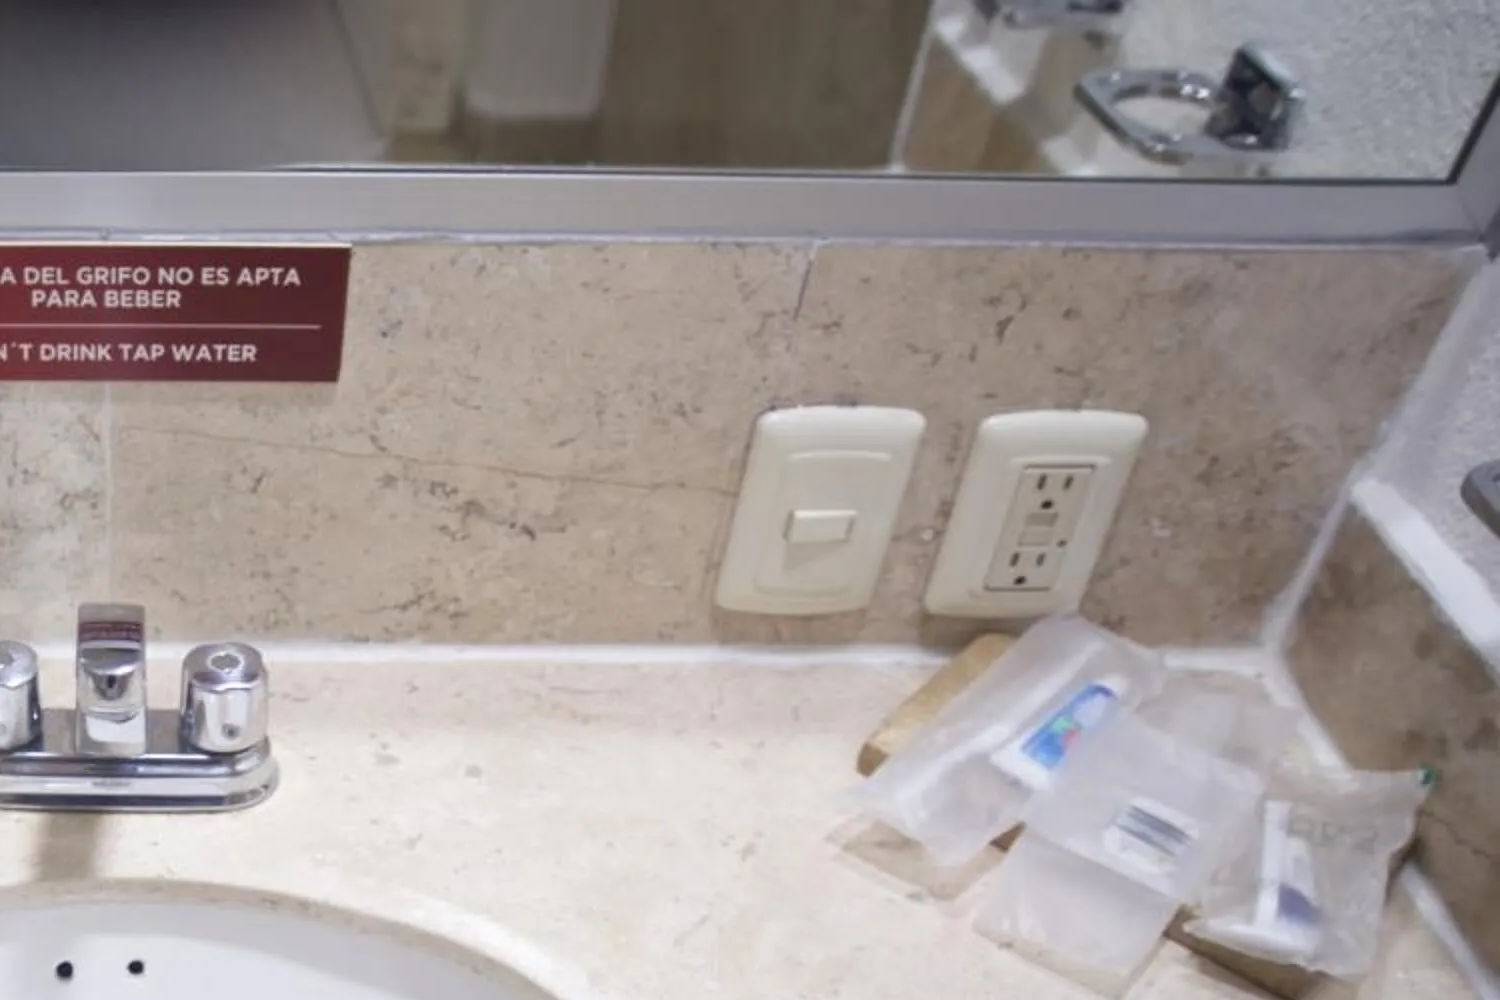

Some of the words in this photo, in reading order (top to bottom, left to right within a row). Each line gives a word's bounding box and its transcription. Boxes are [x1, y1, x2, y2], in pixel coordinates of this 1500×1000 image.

[23, 267, 70, 285] DEL
[75, 266, 151, 286] GRIFO
[157, 266, 194, 286] NO
[200, 267, 229, 286] ES
[236, 267, 301, 286] APTA
[31, 289, 97, 308] PARA
[103, 289, 181, 308] BEBER
[39, 342, 112, 362] DRINK
[118, 343, 165, 362] TAP
[171, 343, 258, 362] WATER
